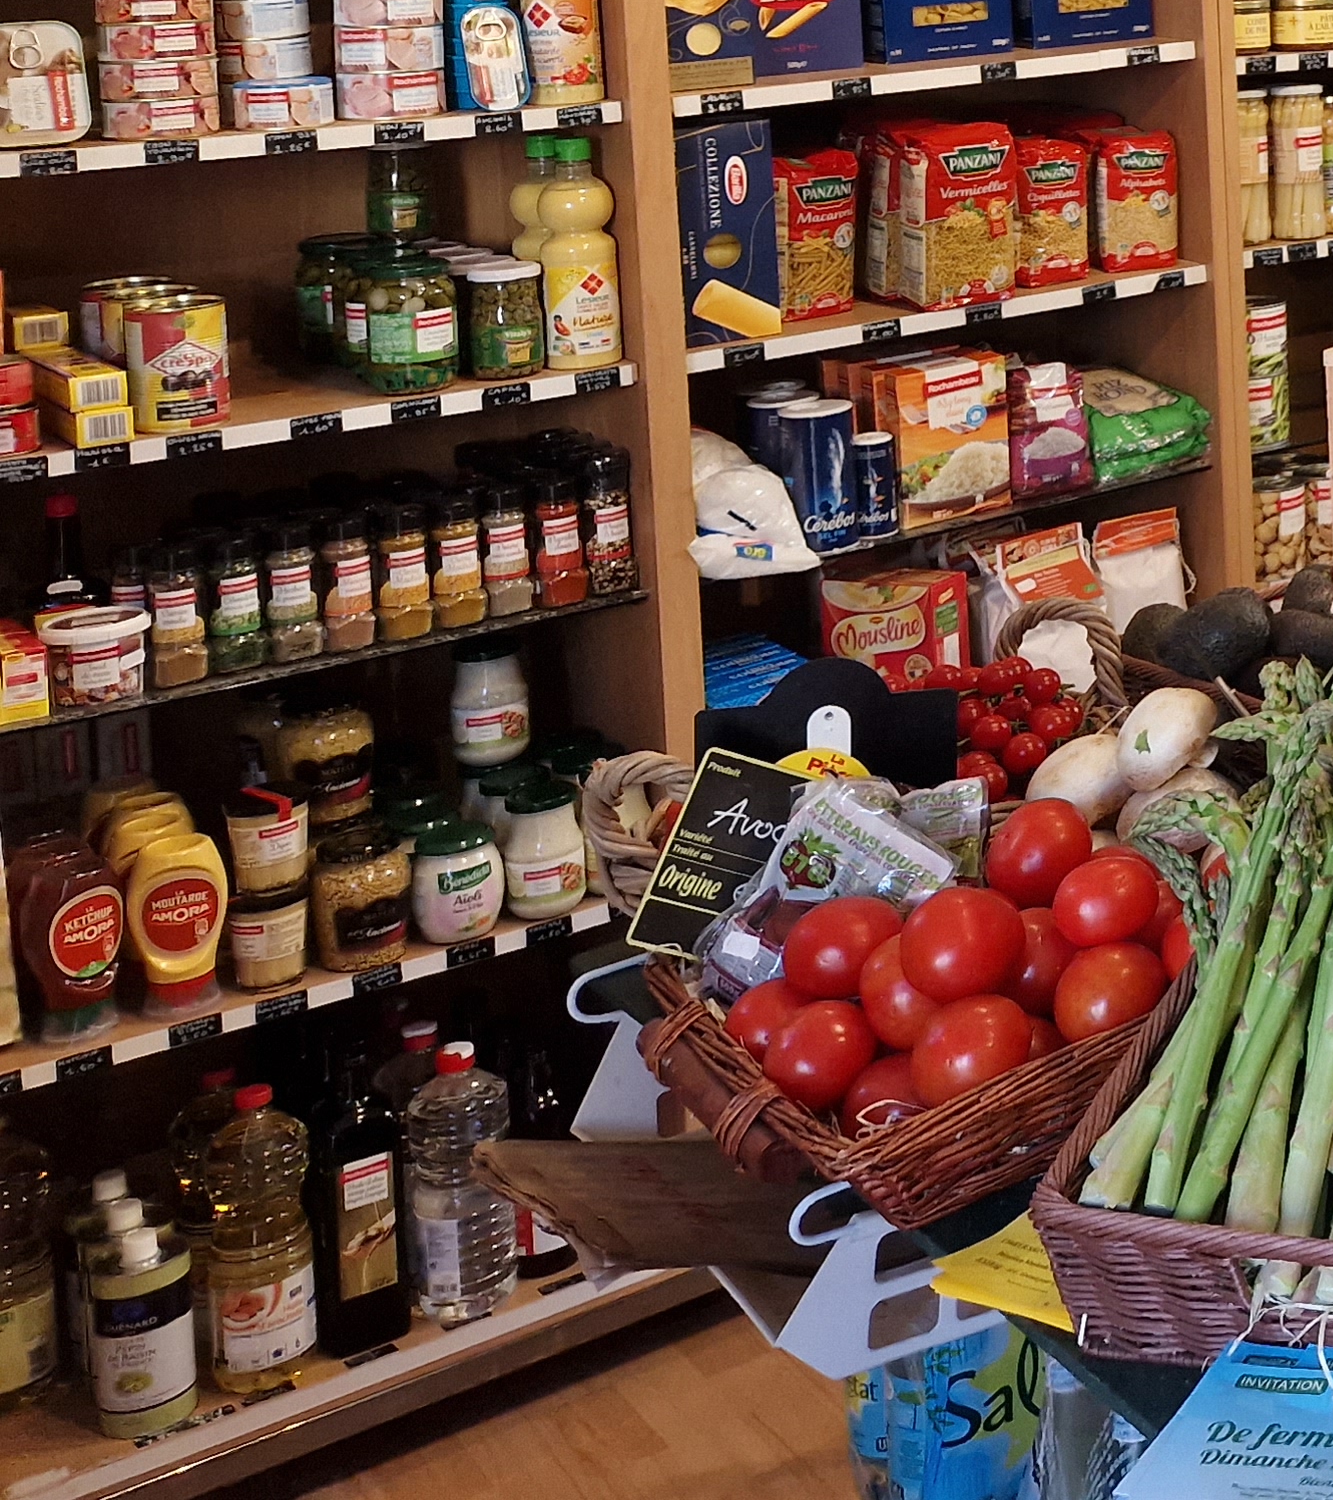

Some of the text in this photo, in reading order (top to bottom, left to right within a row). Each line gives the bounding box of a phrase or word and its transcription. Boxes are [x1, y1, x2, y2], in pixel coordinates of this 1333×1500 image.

[949, 153, 1001, 170] PANZANI
[704, 137, 722, 229] COLLEZIONE
[802, 181, 853, 201] PANZANI
[940, 180, 1008, 200] Vermicelles
[1120, 177, 1166, 189] Alphabets
[1027, 189, 1080, 202] Coquillettes
[797, 207, 853, 224] Macaroni
[572, 313, 614, 327] Nature
[803, 512, 856, 534] Cérébos
[835, 614, 923, 656] Mousline
[707, 761, 741, 778] Produit
[830, 754, 845, 766] La
[679, 828, 713, 844] Variété
[672, 844, 713, 861] Traité au
[658, 864, 724, 900] Origine
[151, 890, 209, 911] MOUTARDE
[64, 904, 114, 933] KETCHUP
[151, 902, 210, 923] AMORA
[62, 918, 115, 945] AMORA
[1240, 1375, 1325, 1392] INVITATION
[1206, 1420, 1252, 1444] De
[1199, 1448, 1328, 1470] Dimanche
